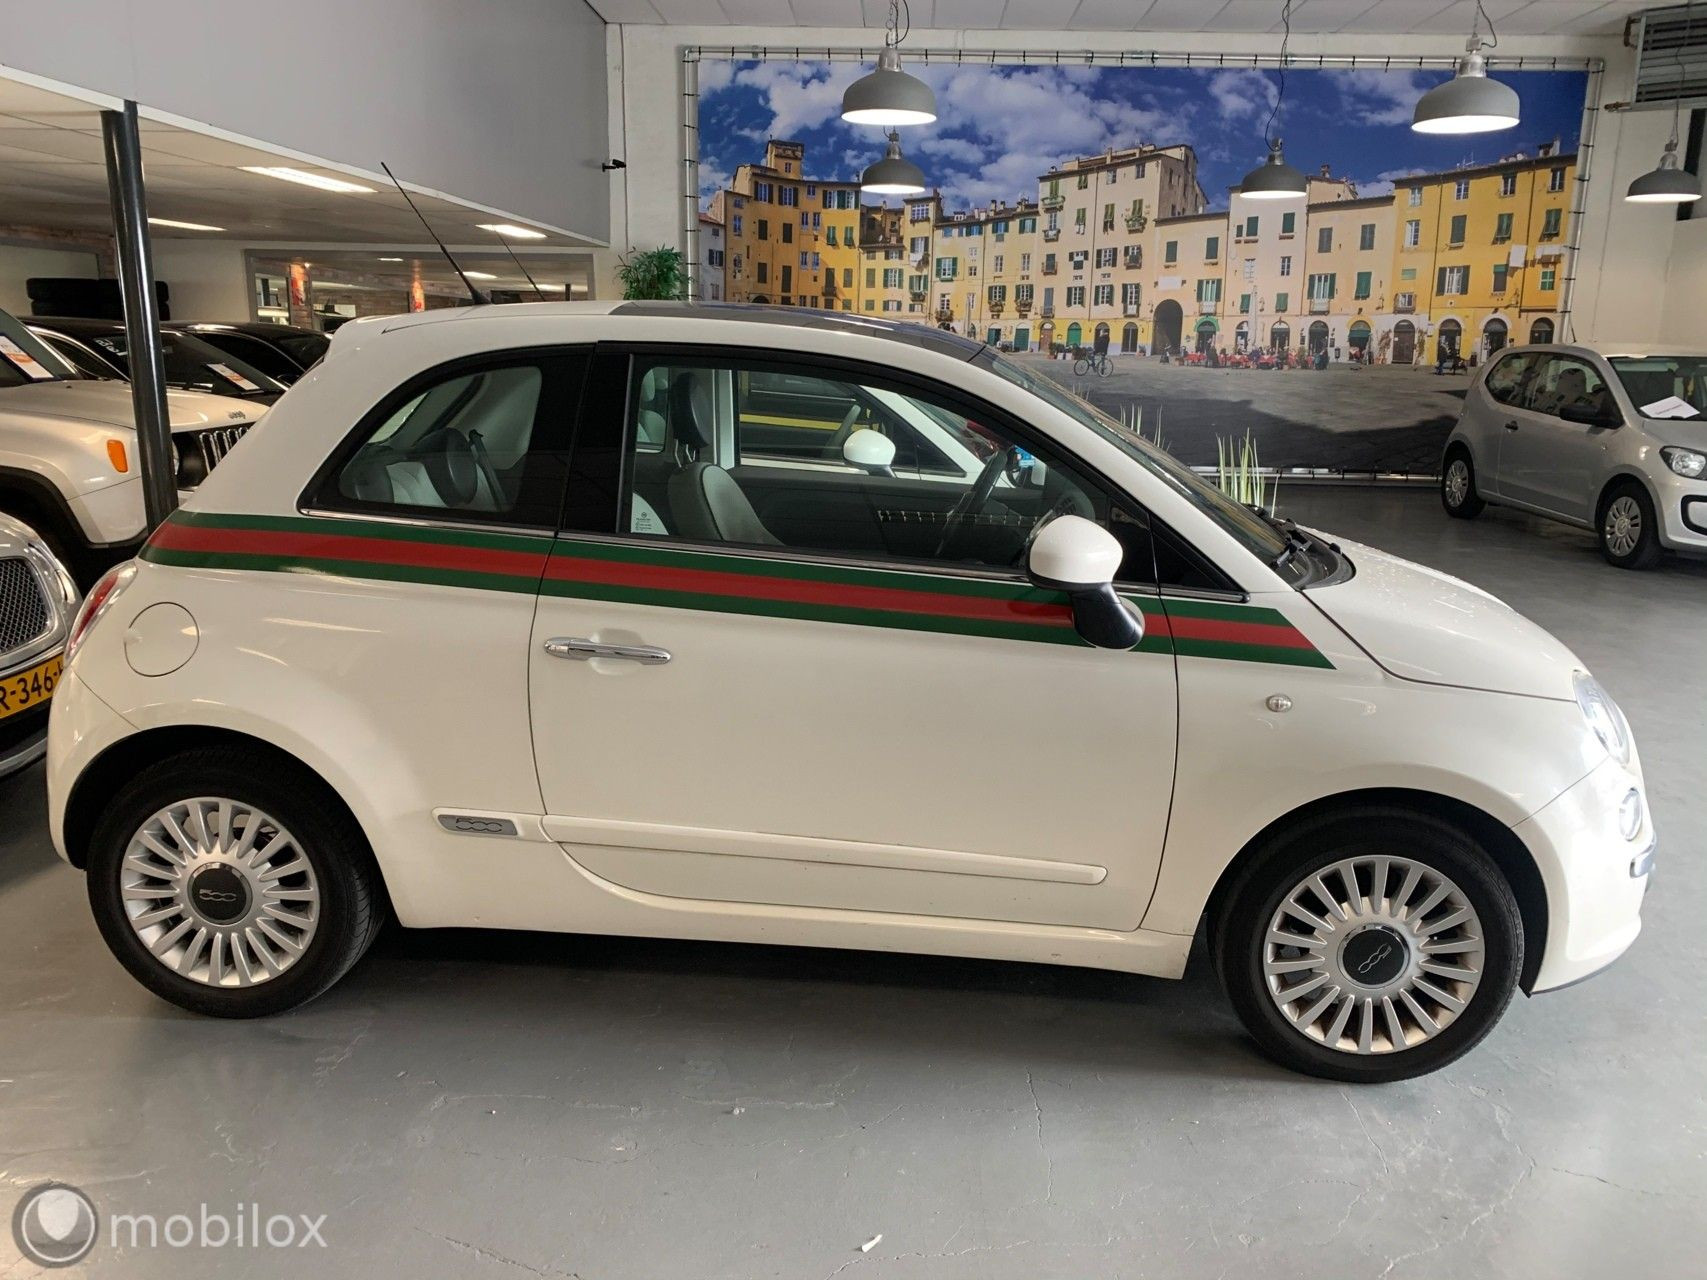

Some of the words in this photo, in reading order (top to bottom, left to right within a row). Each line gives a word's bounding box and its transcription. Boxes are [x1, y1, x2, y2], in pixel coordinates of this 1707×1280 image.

[455, 817, 503, 833] 500
[199, 888, 237, 902] 500
[1357, 942, 1393, 974] 500
